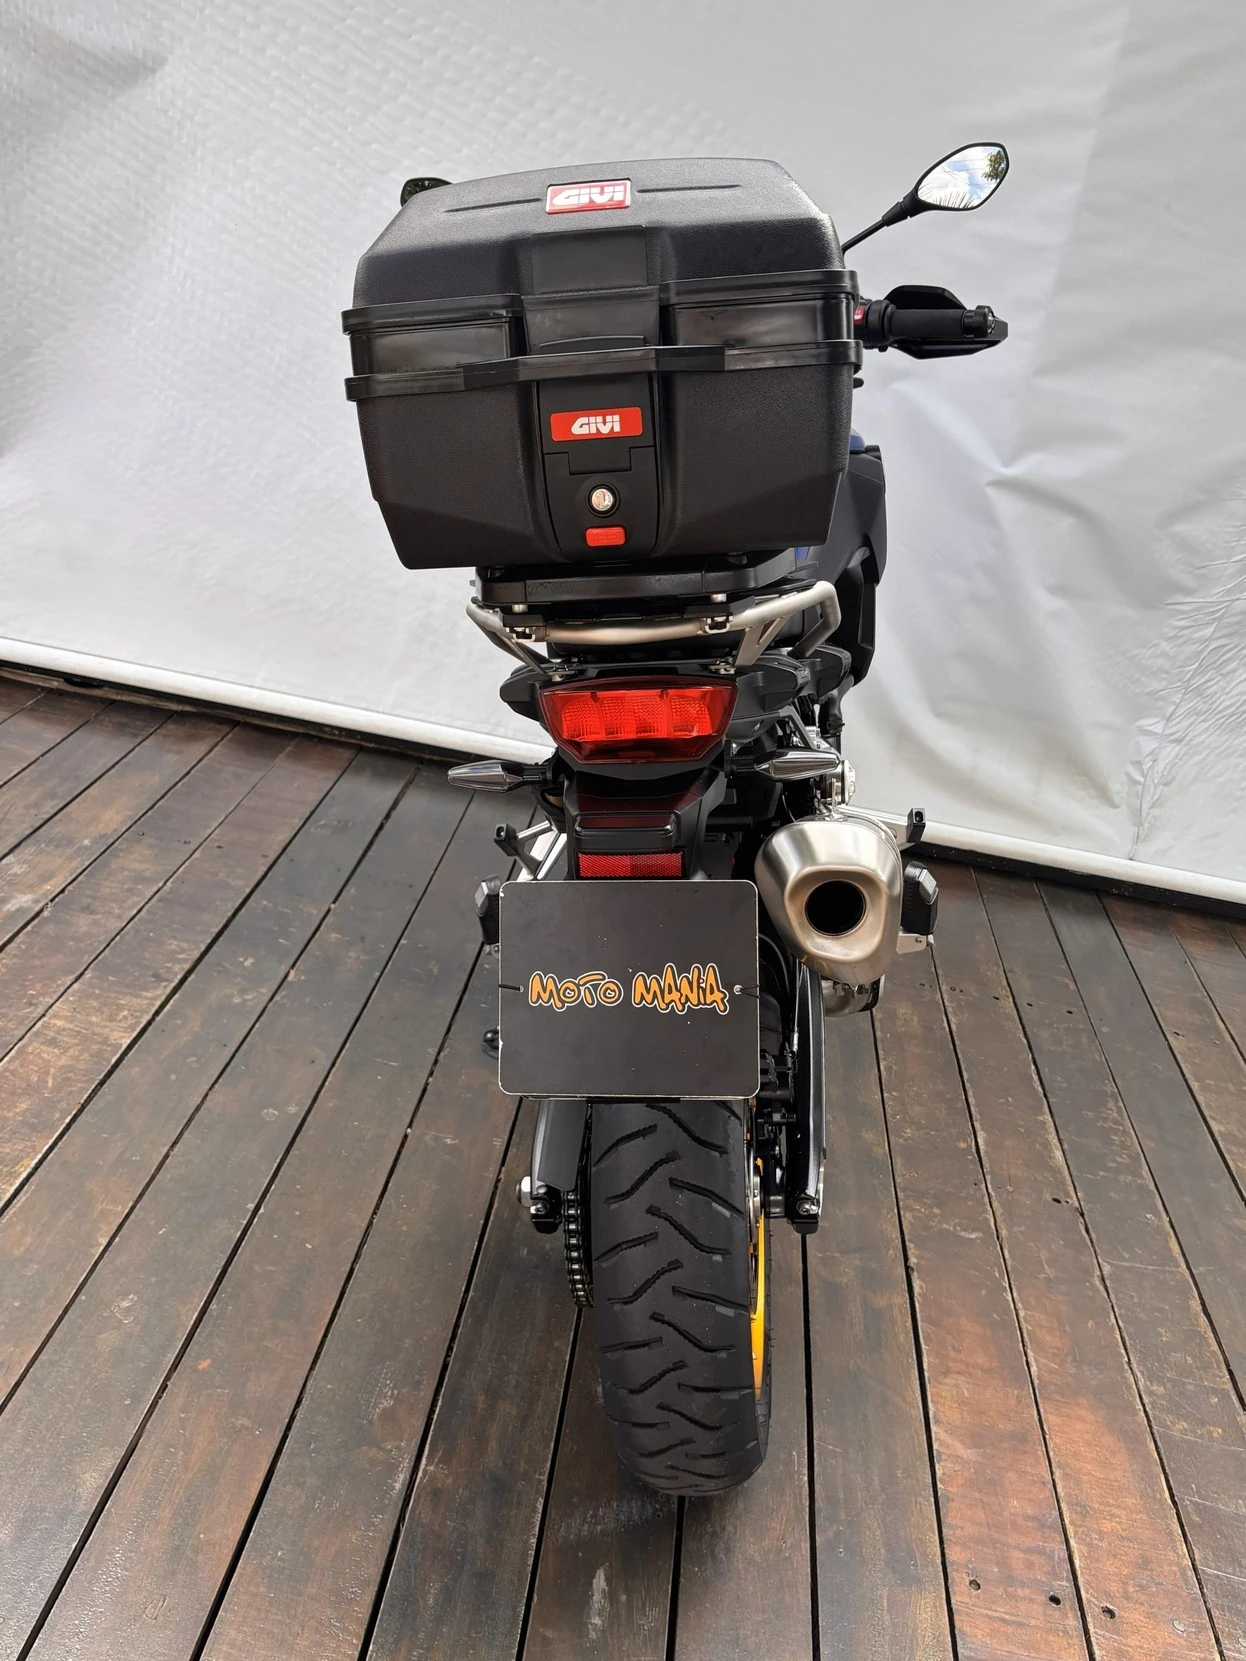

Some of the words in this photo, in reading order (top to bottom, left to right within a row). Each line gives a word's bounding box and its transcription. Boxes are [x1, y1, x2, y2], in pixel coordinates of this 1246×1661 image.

[552, 185, 625, 206] GIVI
[571, 414, 621, 435] GIVI
[529, 971, 624, 1012] MOTO
